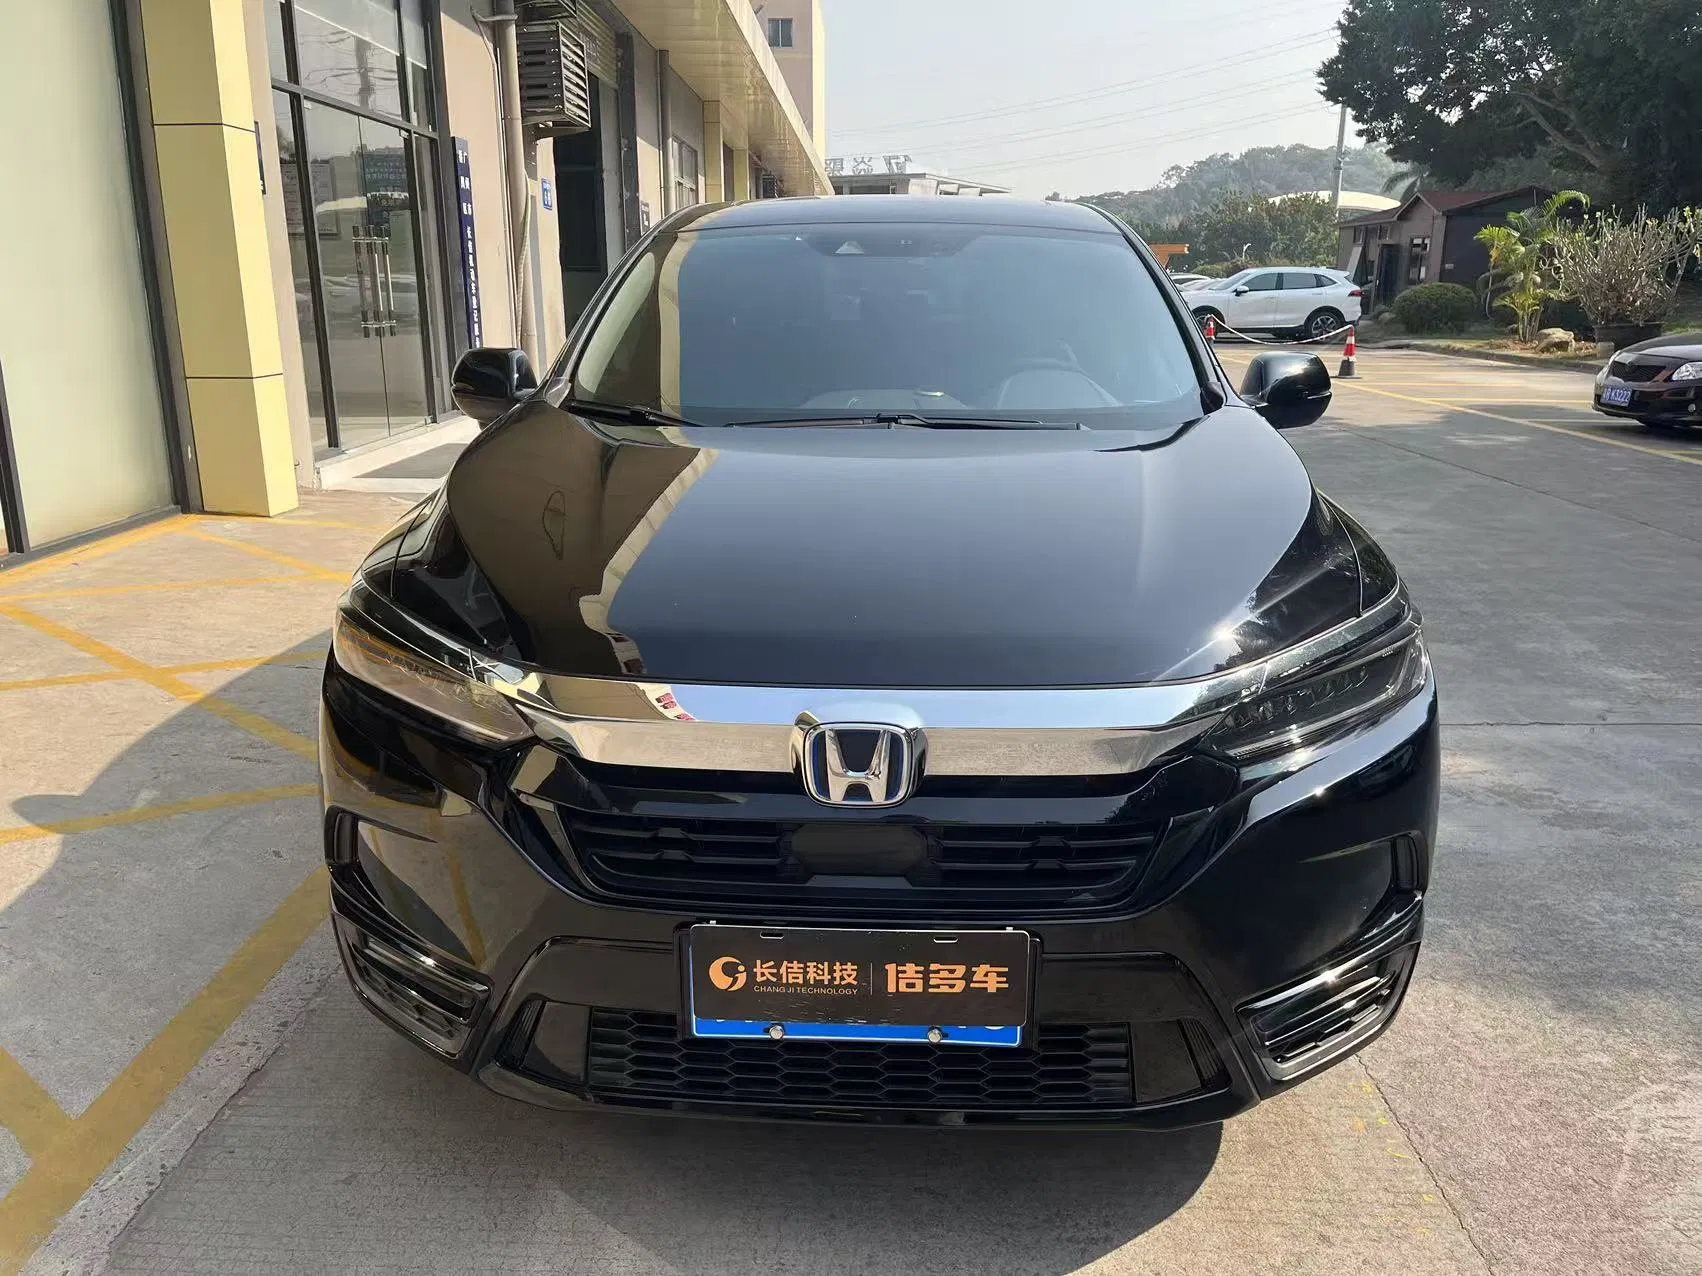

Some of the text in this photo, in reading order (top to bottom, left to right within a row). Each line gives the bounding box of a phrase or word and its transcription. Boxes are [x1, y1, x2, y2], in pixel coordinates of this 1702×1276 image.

[753, 959, 1009, 993] 长佶科技 佶多车
[753, 985, 786, 993] CHANG
[796, 987, 858, 995] TECHNOLOGY
